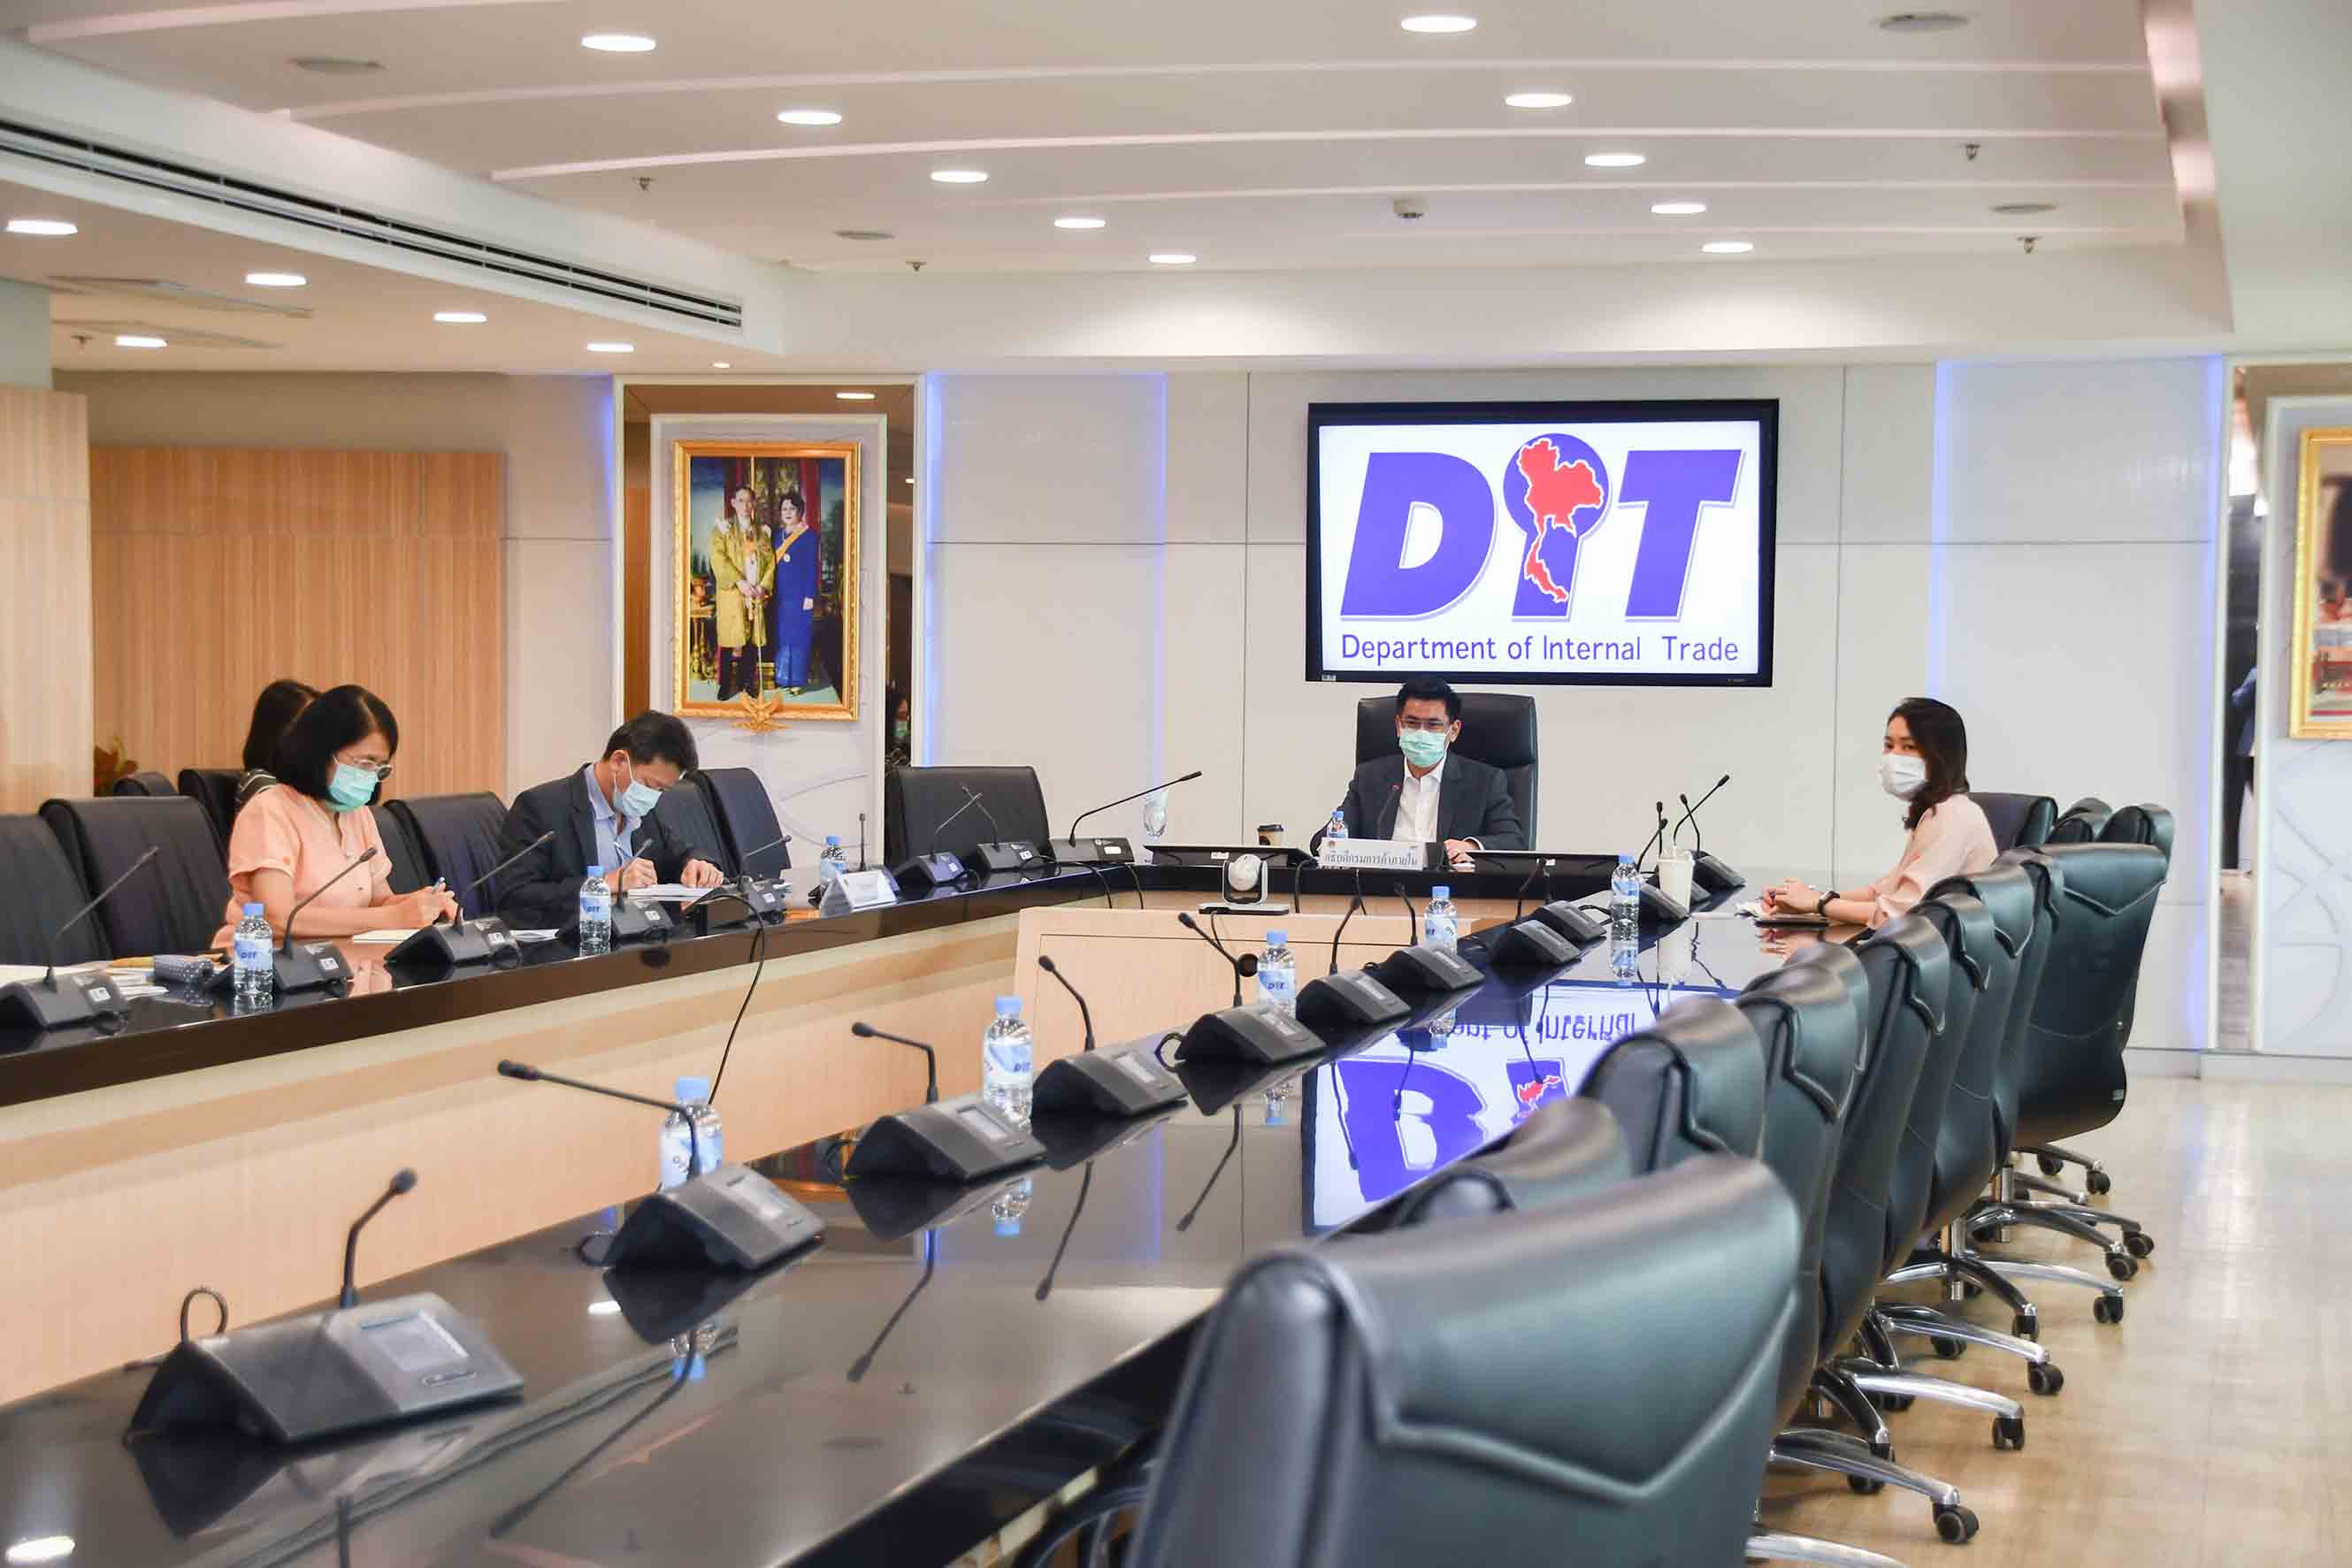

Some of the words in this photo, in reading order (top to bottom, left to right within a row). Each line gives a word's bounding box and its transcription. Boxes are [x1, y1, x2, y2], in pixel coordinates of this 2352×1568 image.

[1341, 634, 1498, 666] Department
[1507, 634, 1533, 661] of
[1543, 635, 1642, 662] Internal
[1662, 636, 1739, 662] Trade
